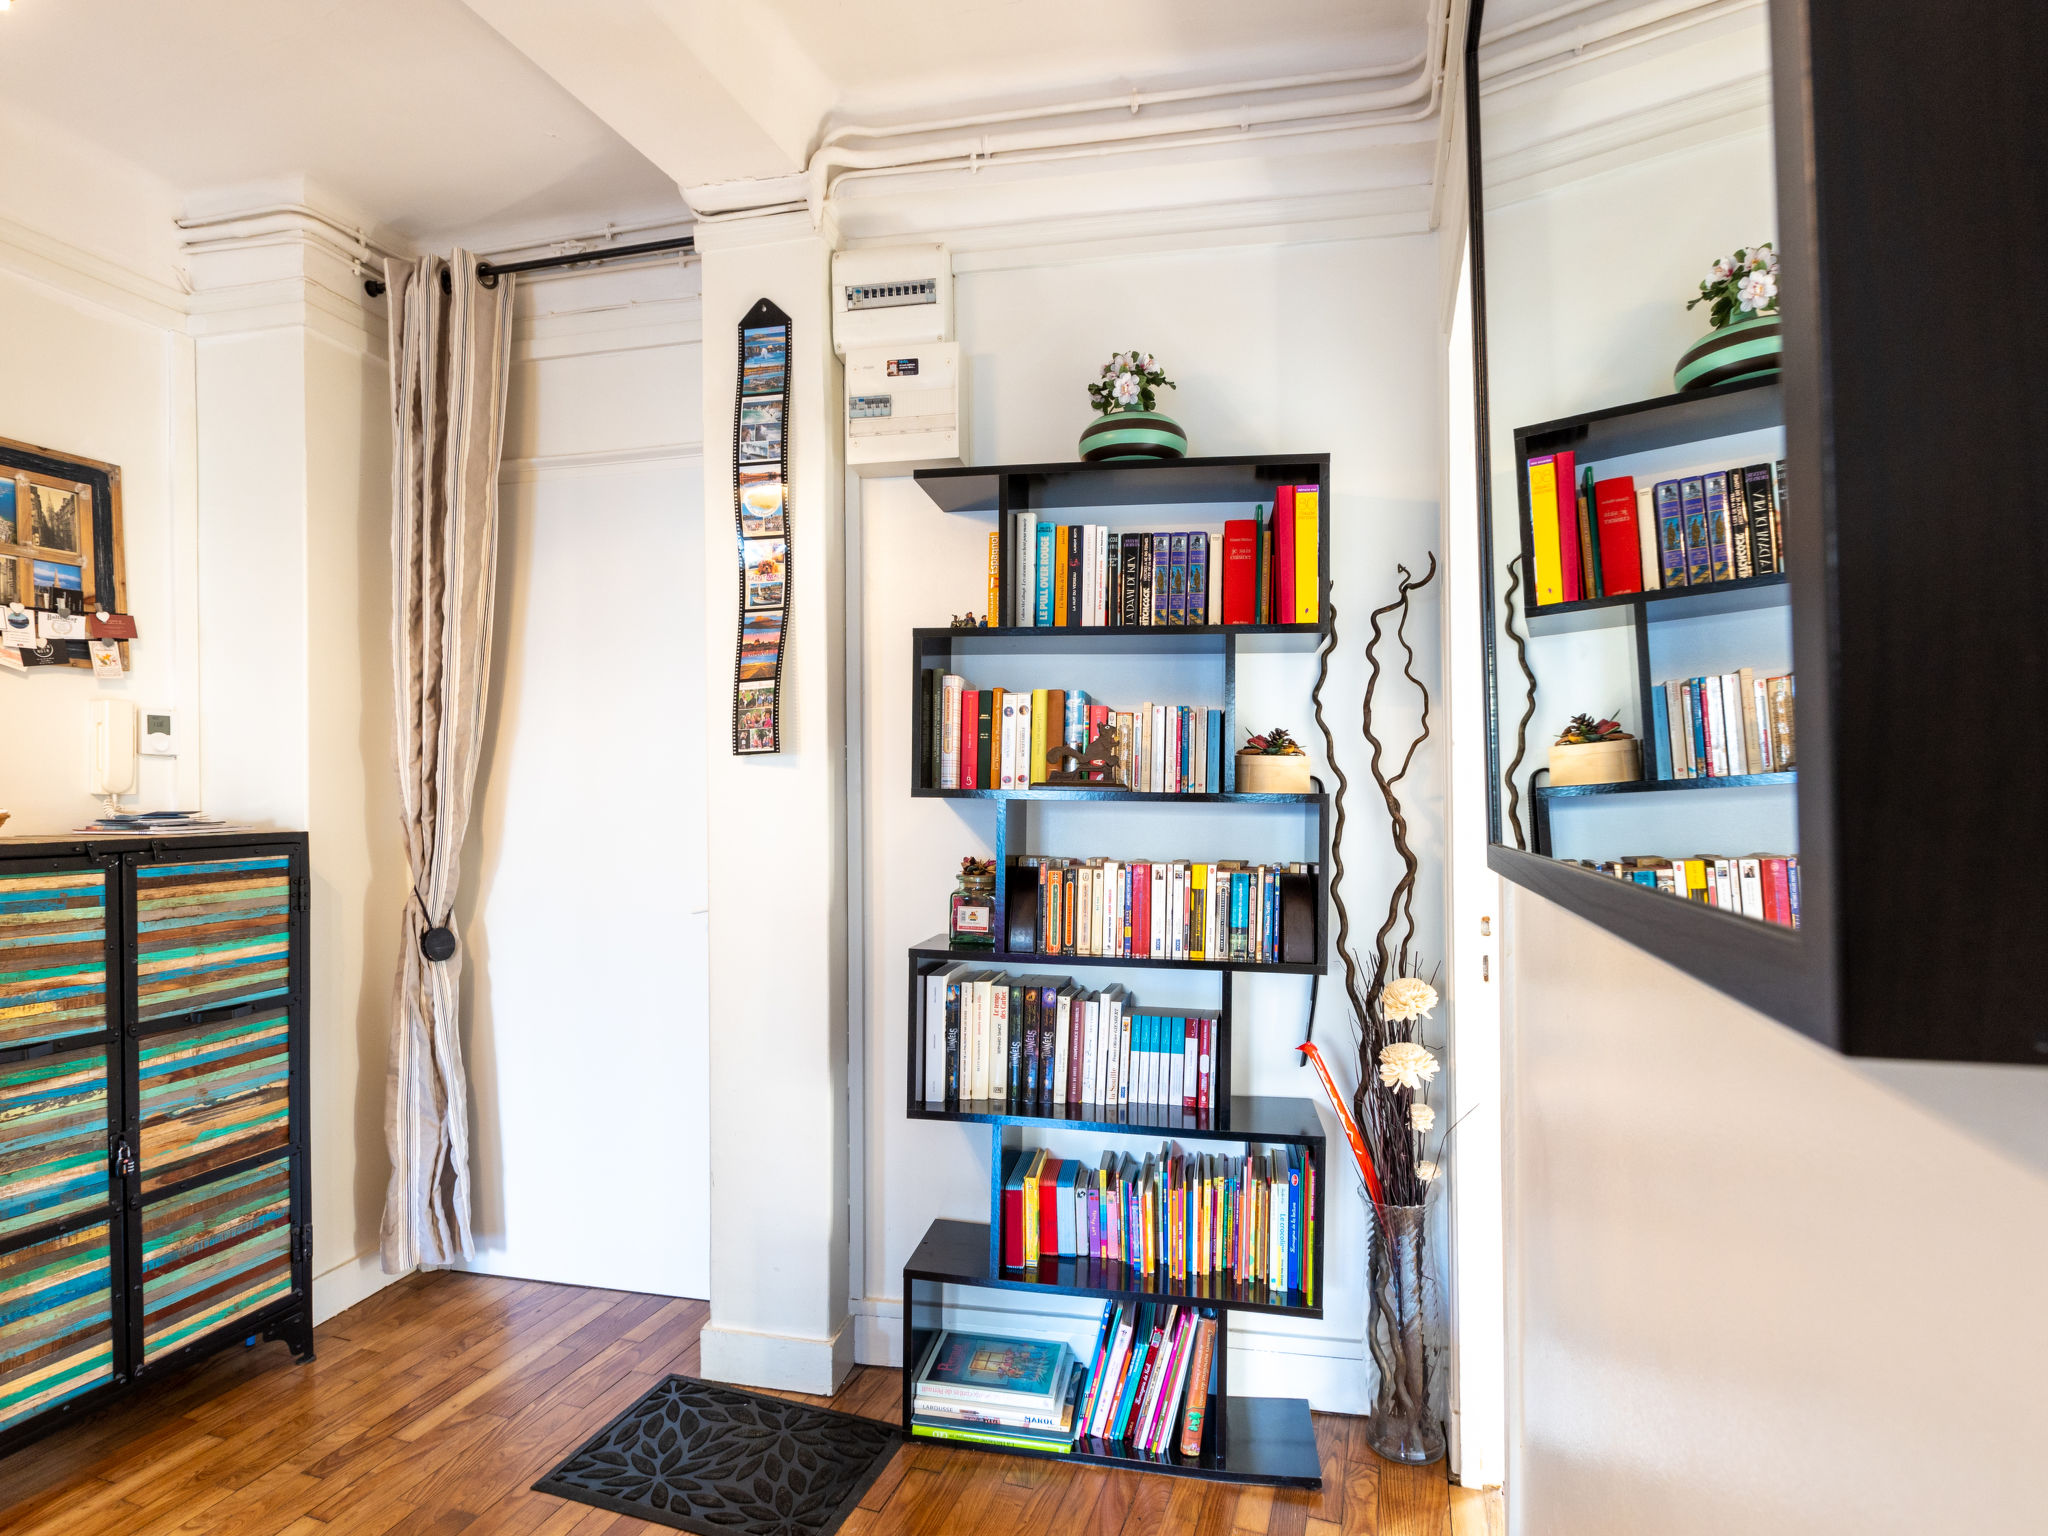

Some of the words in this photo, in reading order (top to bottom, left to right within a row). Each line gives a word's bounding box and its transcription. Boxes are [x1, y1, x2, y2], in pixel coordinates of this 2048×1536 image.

[1040, 536, 1049, 564] ROUGE
[1040, 565, 1048, 588] OVER
[1040, 589, 1048, 609] PULL
[1040, 611, 1047, 620] LE
[947, 1028, 958, 1052] TUNNELS
[1024, 1030, 1037, 1057] TUNNELS
[1041, 1032, 1054, 1059] TUNNELS
[1009, 1041, 1021, 1069] TUNNELS
[1280, 1214, 1286, 1222] Le
